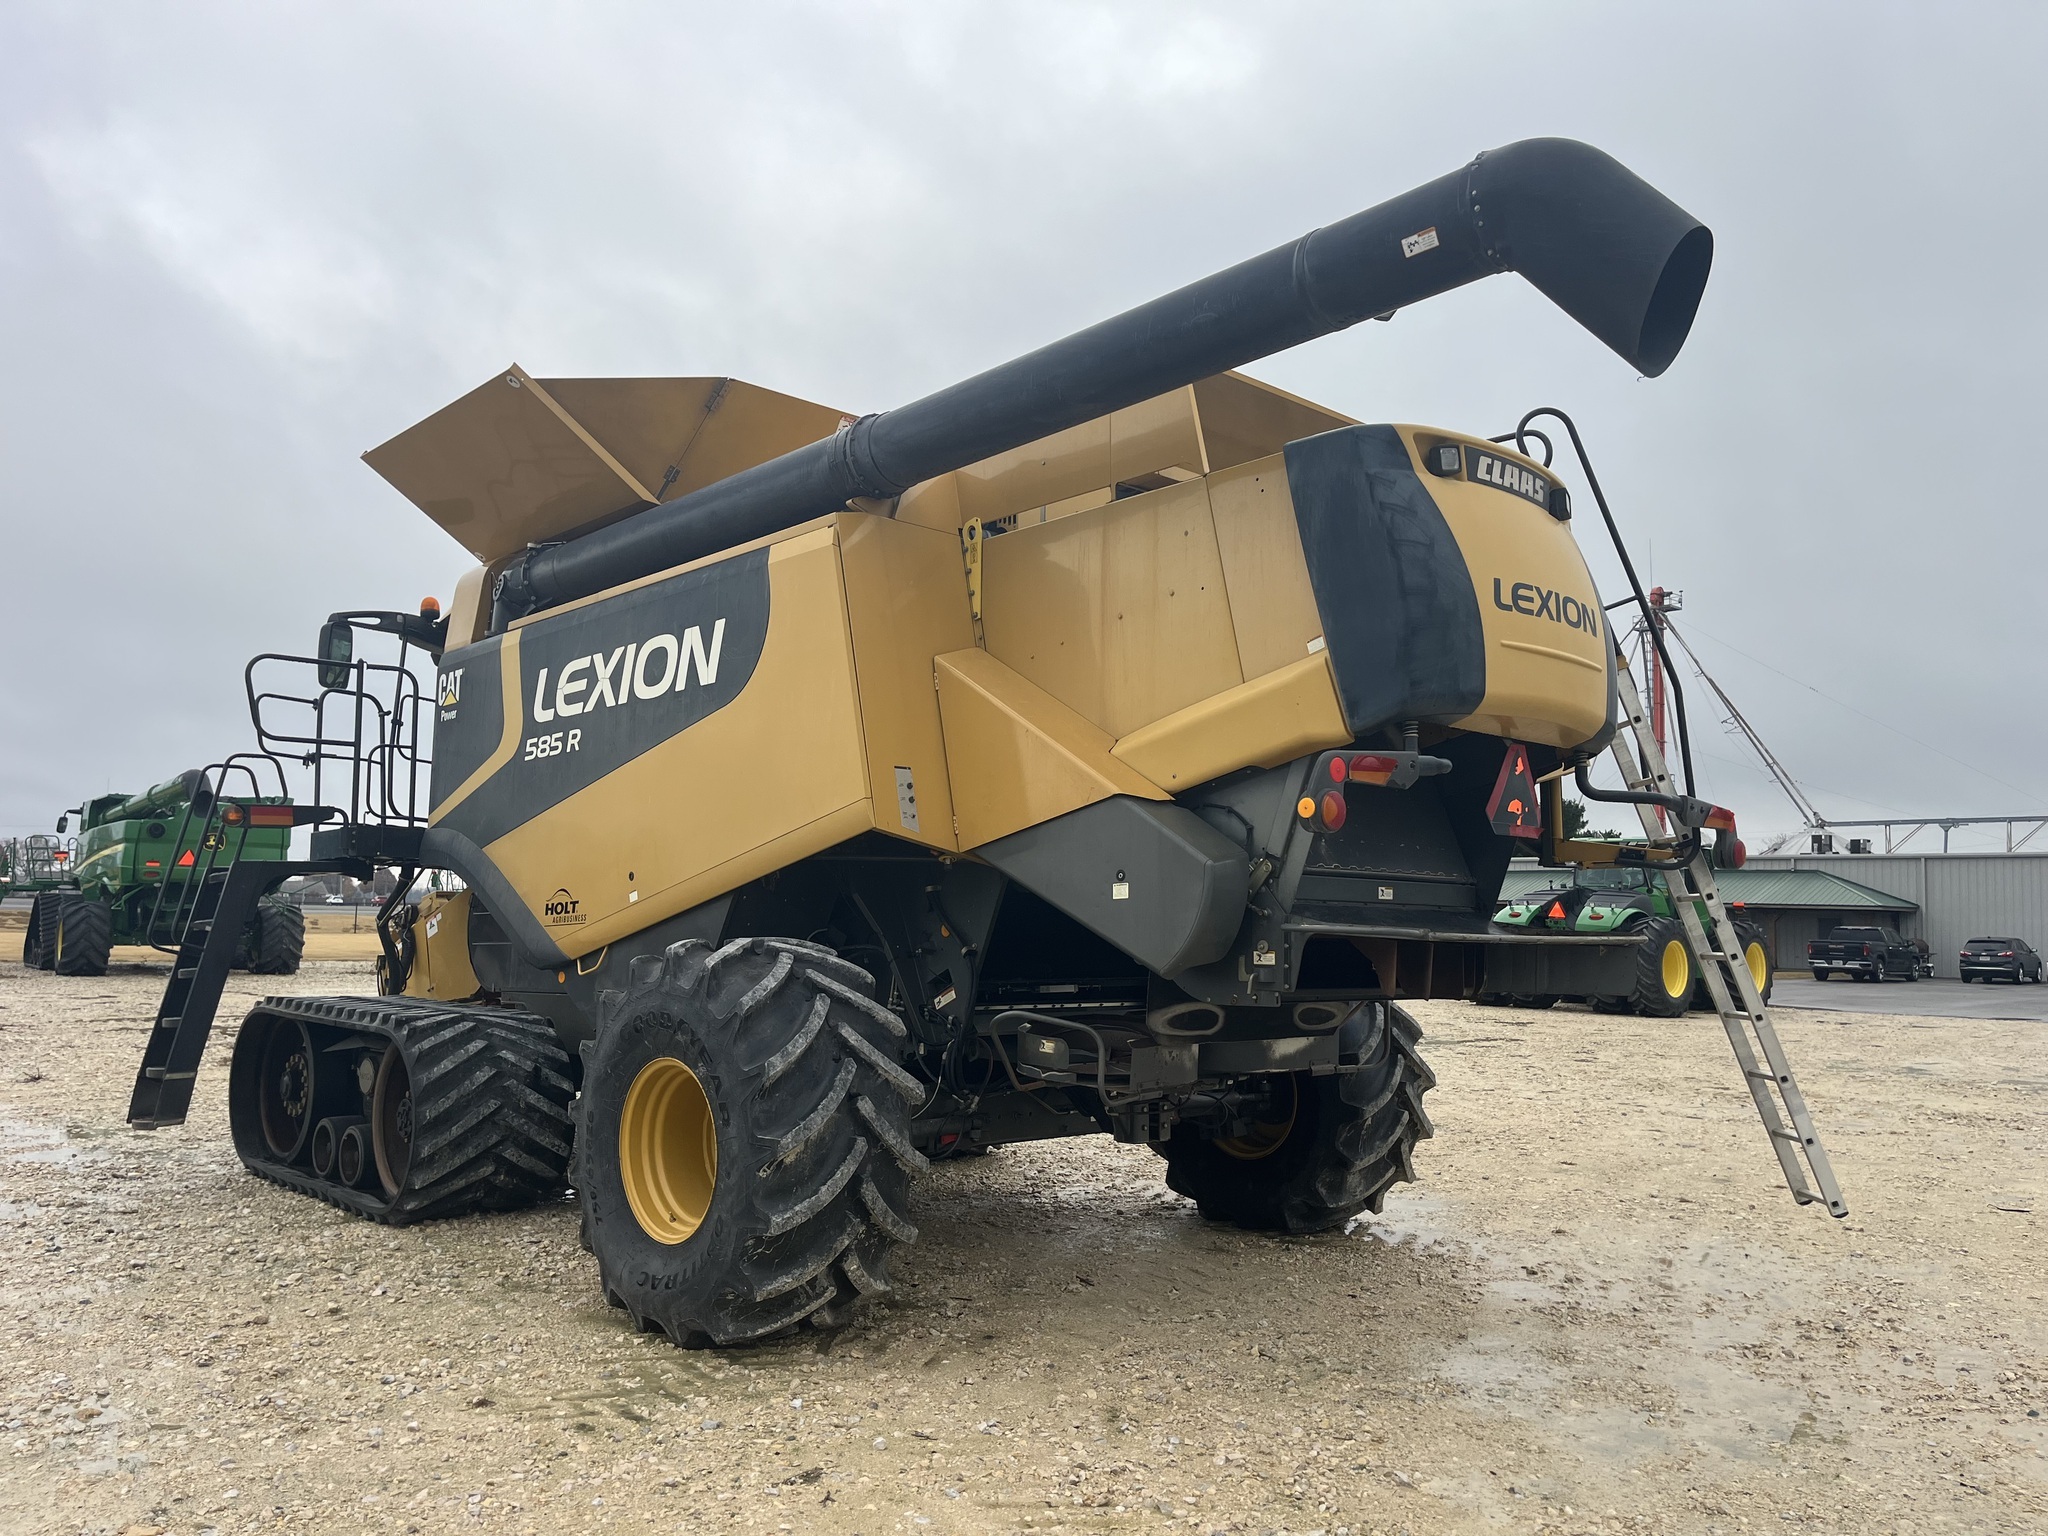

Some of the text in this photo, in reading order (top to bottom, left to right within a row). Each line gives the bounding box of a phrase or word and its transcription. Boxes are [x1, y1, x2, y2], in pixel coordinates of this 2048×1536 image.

[1477, 456, 1544, 502] CLAAS
[1493, 578, 1597, 638] LEXION
[438, 668, 463, 706] CAT
[533, 618, 726, 723] LEXION
[440, 709, 457, 722] Power
[524, 729, 581, 761] 585 R
[544, 900, 579, 916] HOLT
[552, 913, 587, 924] AGRIBUSINESS
